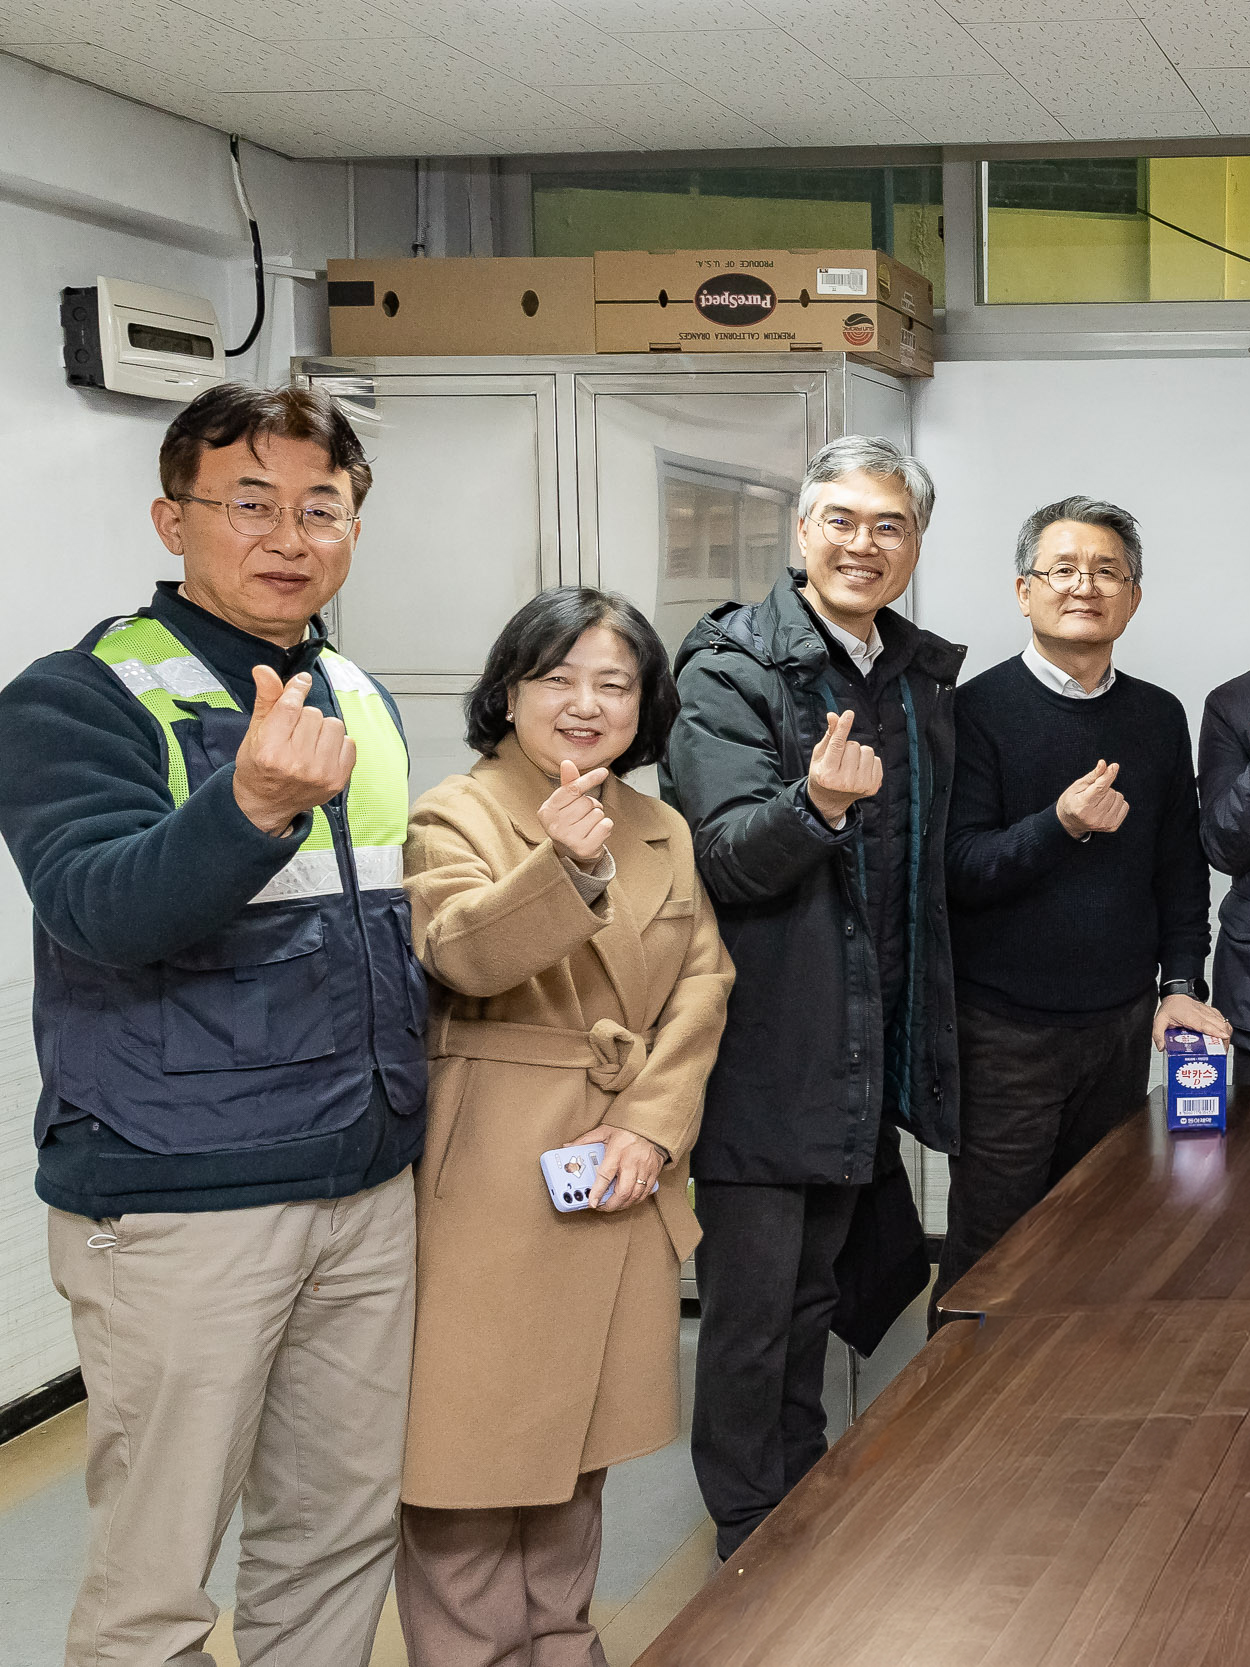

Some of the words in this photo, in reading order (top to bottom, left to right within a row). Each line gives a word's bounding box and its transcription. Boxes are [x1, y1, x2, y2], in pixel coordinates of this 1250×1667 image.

[725, 260, 735, 268] OF
[740, 260, 774, 268] PRODUCE
[699, 291, 772, 308] PureSpect
[678, 332, 711, 340] ORANGES
[714, 332, 760, 340] CALIFORNIA
[763, 332, 796, 340] PREMIUM
[1181, 1069, 1213, 1078] 박카스
